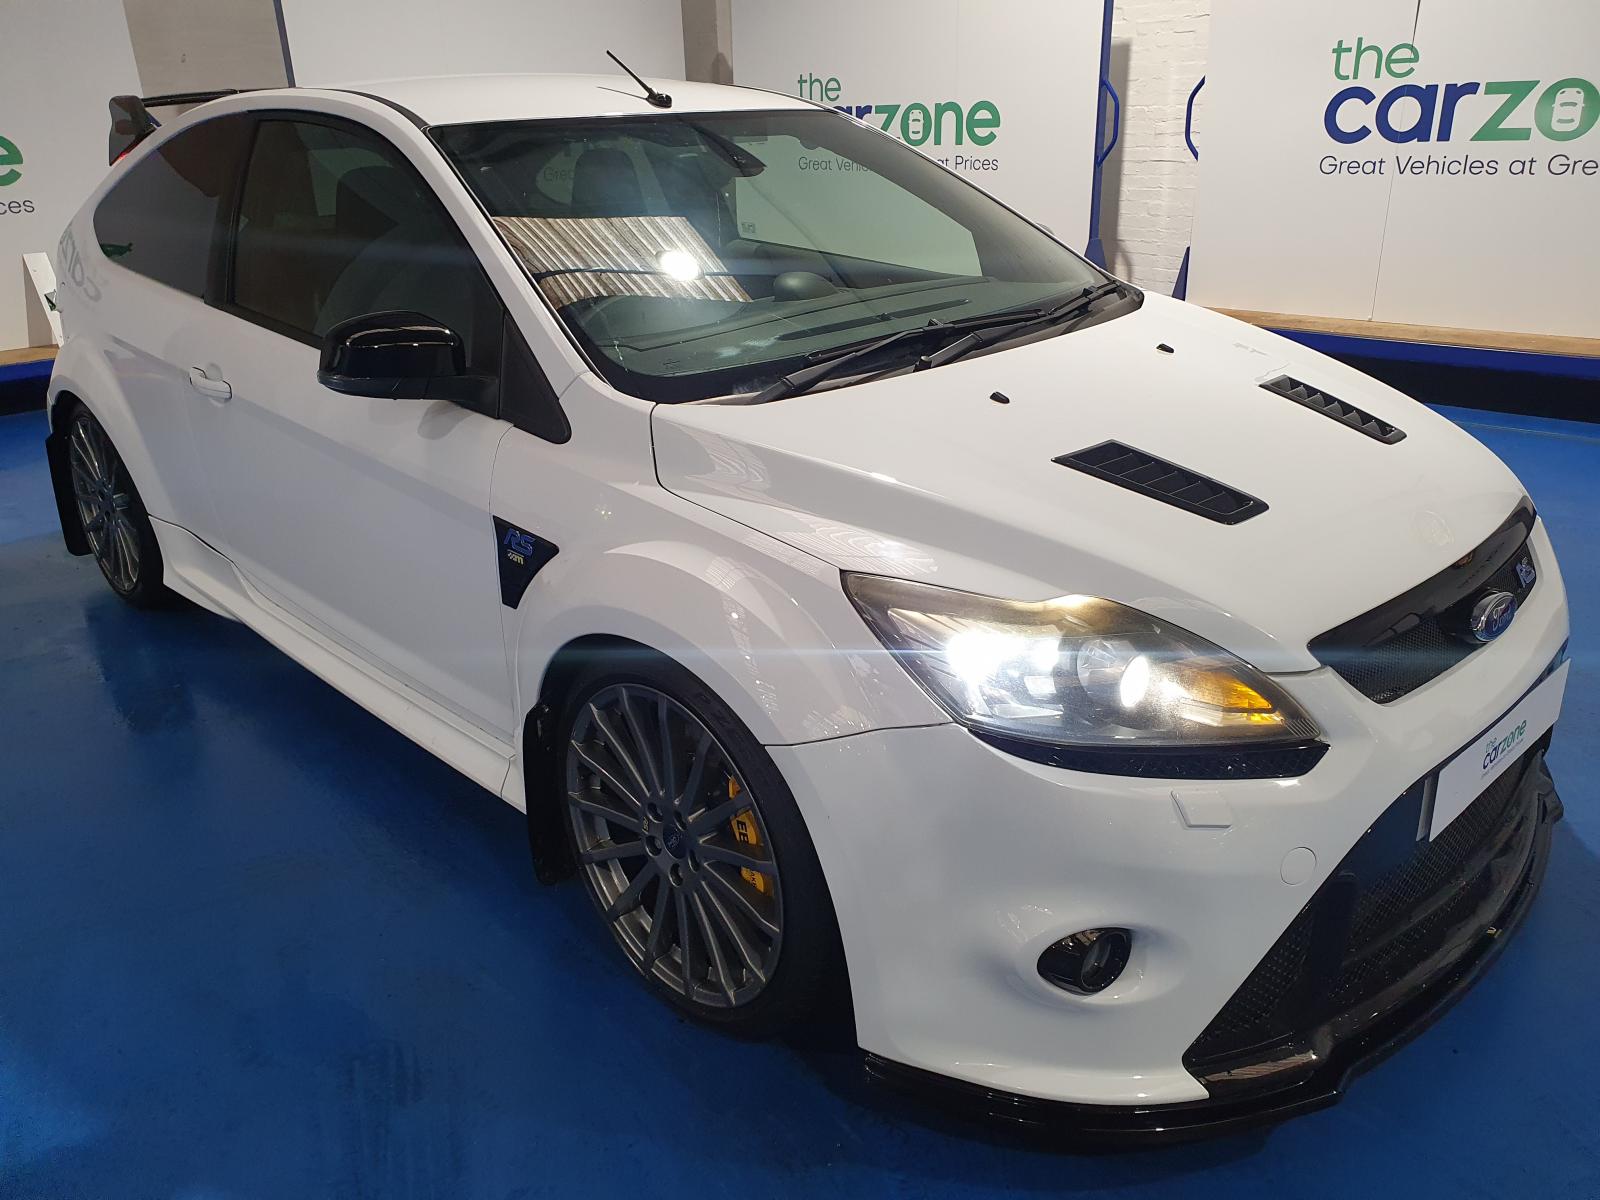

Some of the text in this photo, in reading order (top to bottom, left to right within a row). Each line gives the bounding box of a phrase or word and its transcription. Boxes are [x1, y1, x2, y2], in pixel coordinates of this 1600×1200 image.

[1331, 36, 1420, 81] the
[797, 72, 842, 102] the
[798, 156, 833, 171] Great
[954, 155, 999, 171] Prices
[1319, 155, 1386, 176] Great
[1395, 154, 1499, 176] Vehicles
[1508, 156, 1537, 176] at
[1482, 719, 1527, 770] carzone
